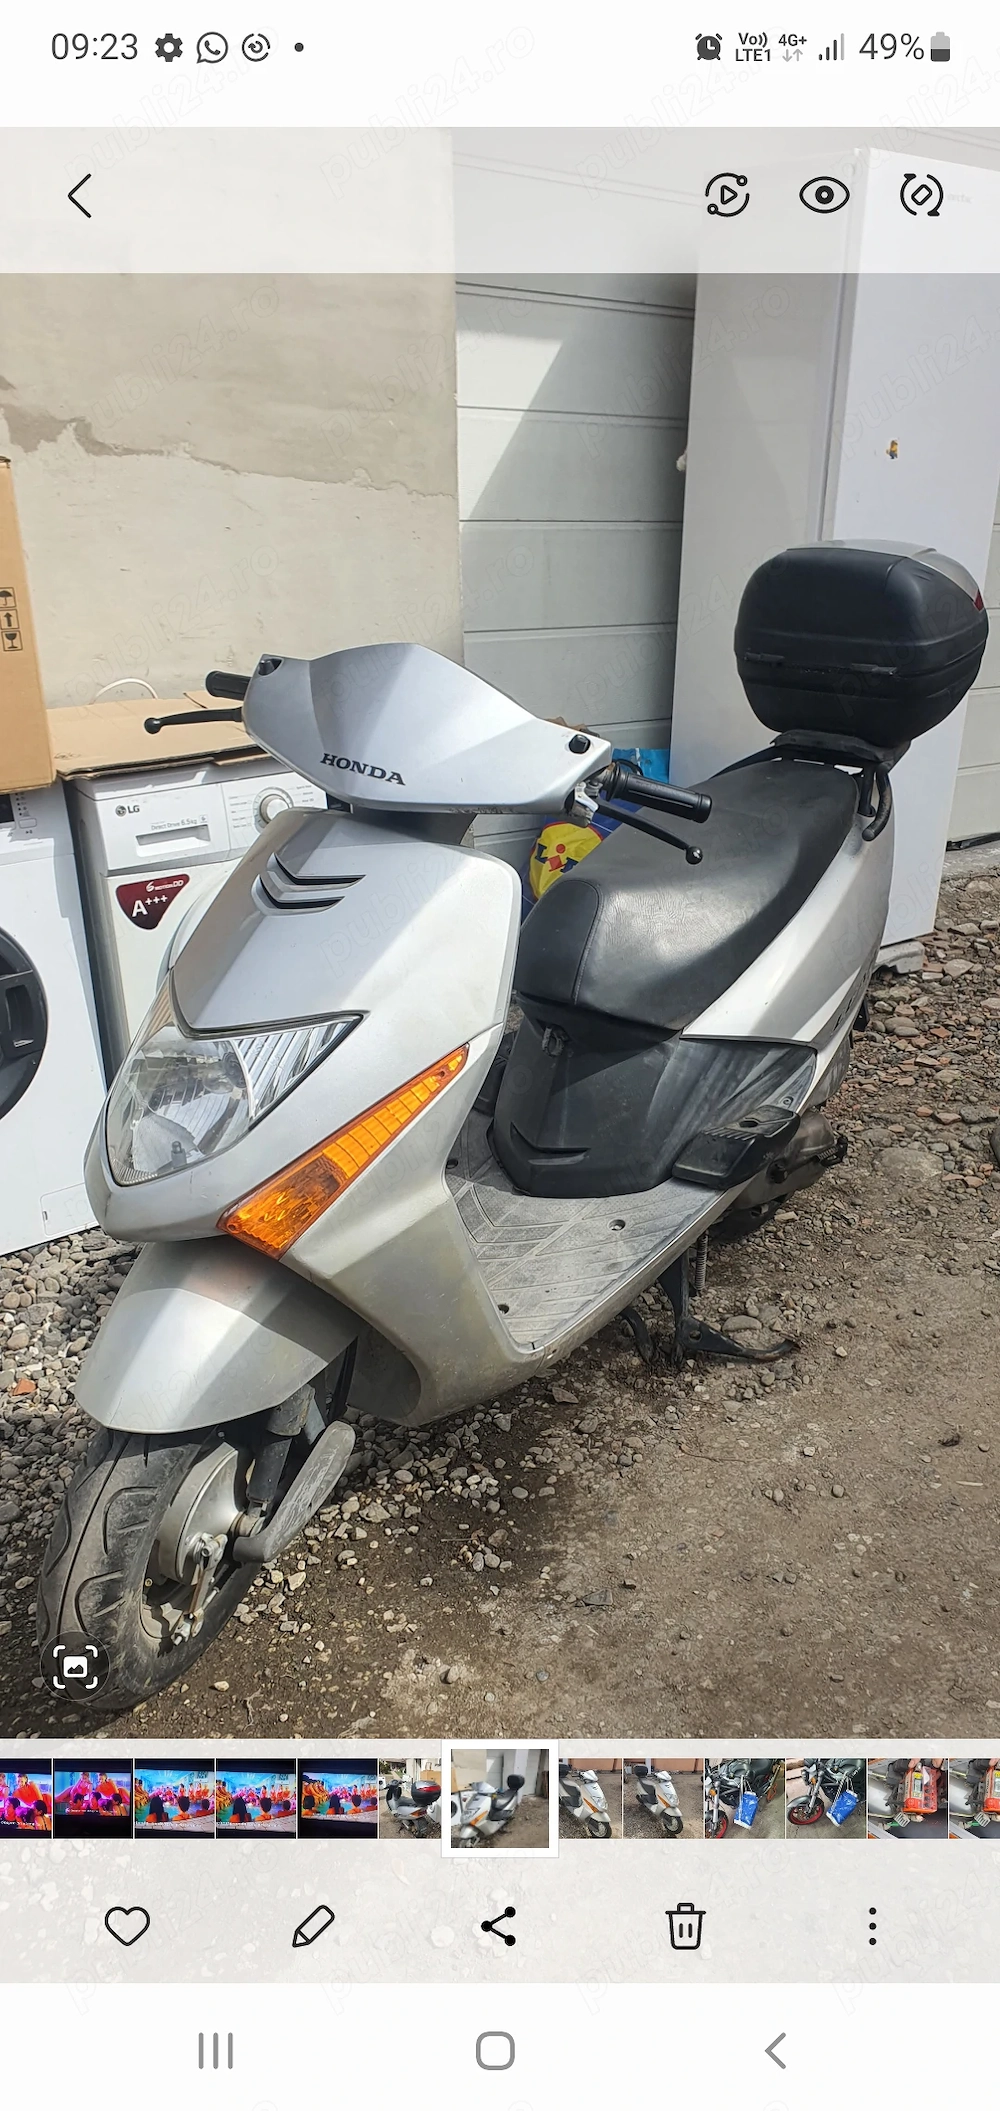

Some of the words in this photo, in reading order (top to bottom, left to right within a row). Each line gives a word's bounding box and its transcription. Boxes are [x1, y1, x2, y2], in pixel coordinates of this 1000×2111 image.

[51, 32, 138, 60] 09:23
[778, 33, 807, 46] 4G+
[858, 33, 925, 60] 49%
[735, 48, 771, 62] LTE1
[320, 752, 406, 786] HONDA
[127, 805, 141, 814] LG
[132, 894, 169, 918] A+++
